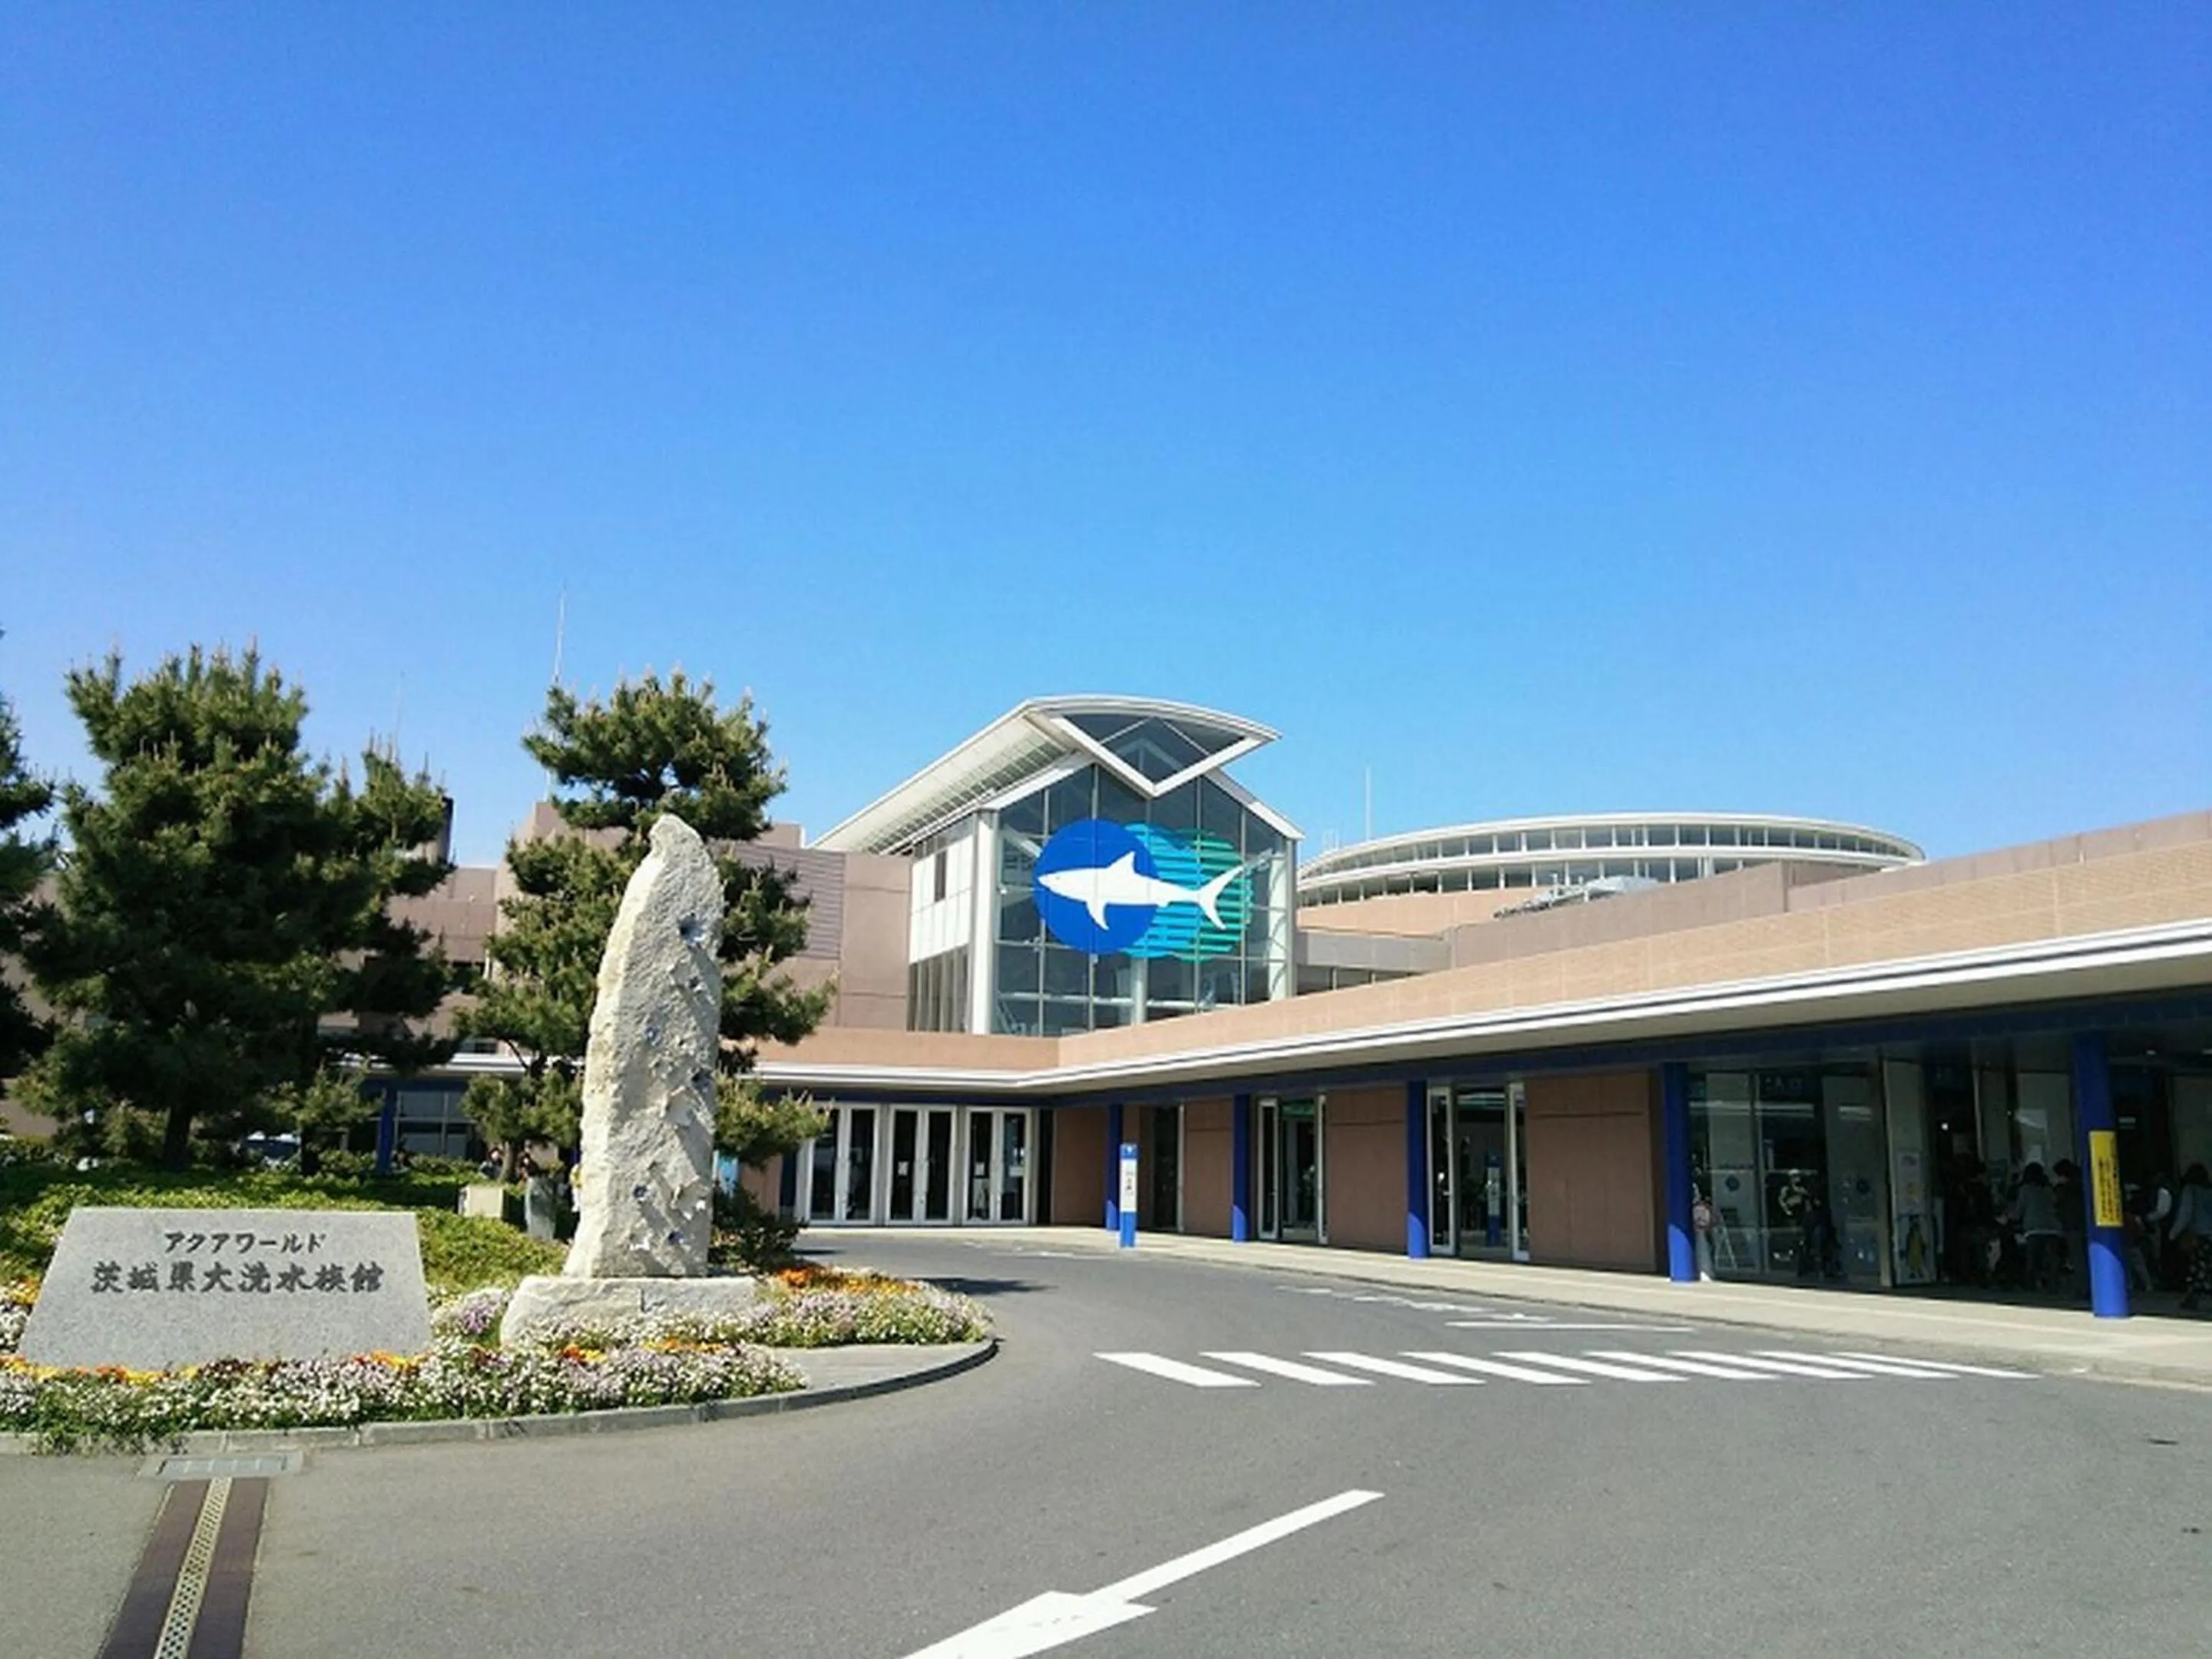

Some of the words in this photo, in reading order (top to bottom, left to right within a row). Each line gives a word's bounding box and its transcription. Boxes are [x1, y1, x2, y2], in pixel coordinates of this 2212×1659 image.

[164, 1231, 326, 1253] アクアワールド
[91, 1260, 385, 1293] 茨城県大洗水族館
